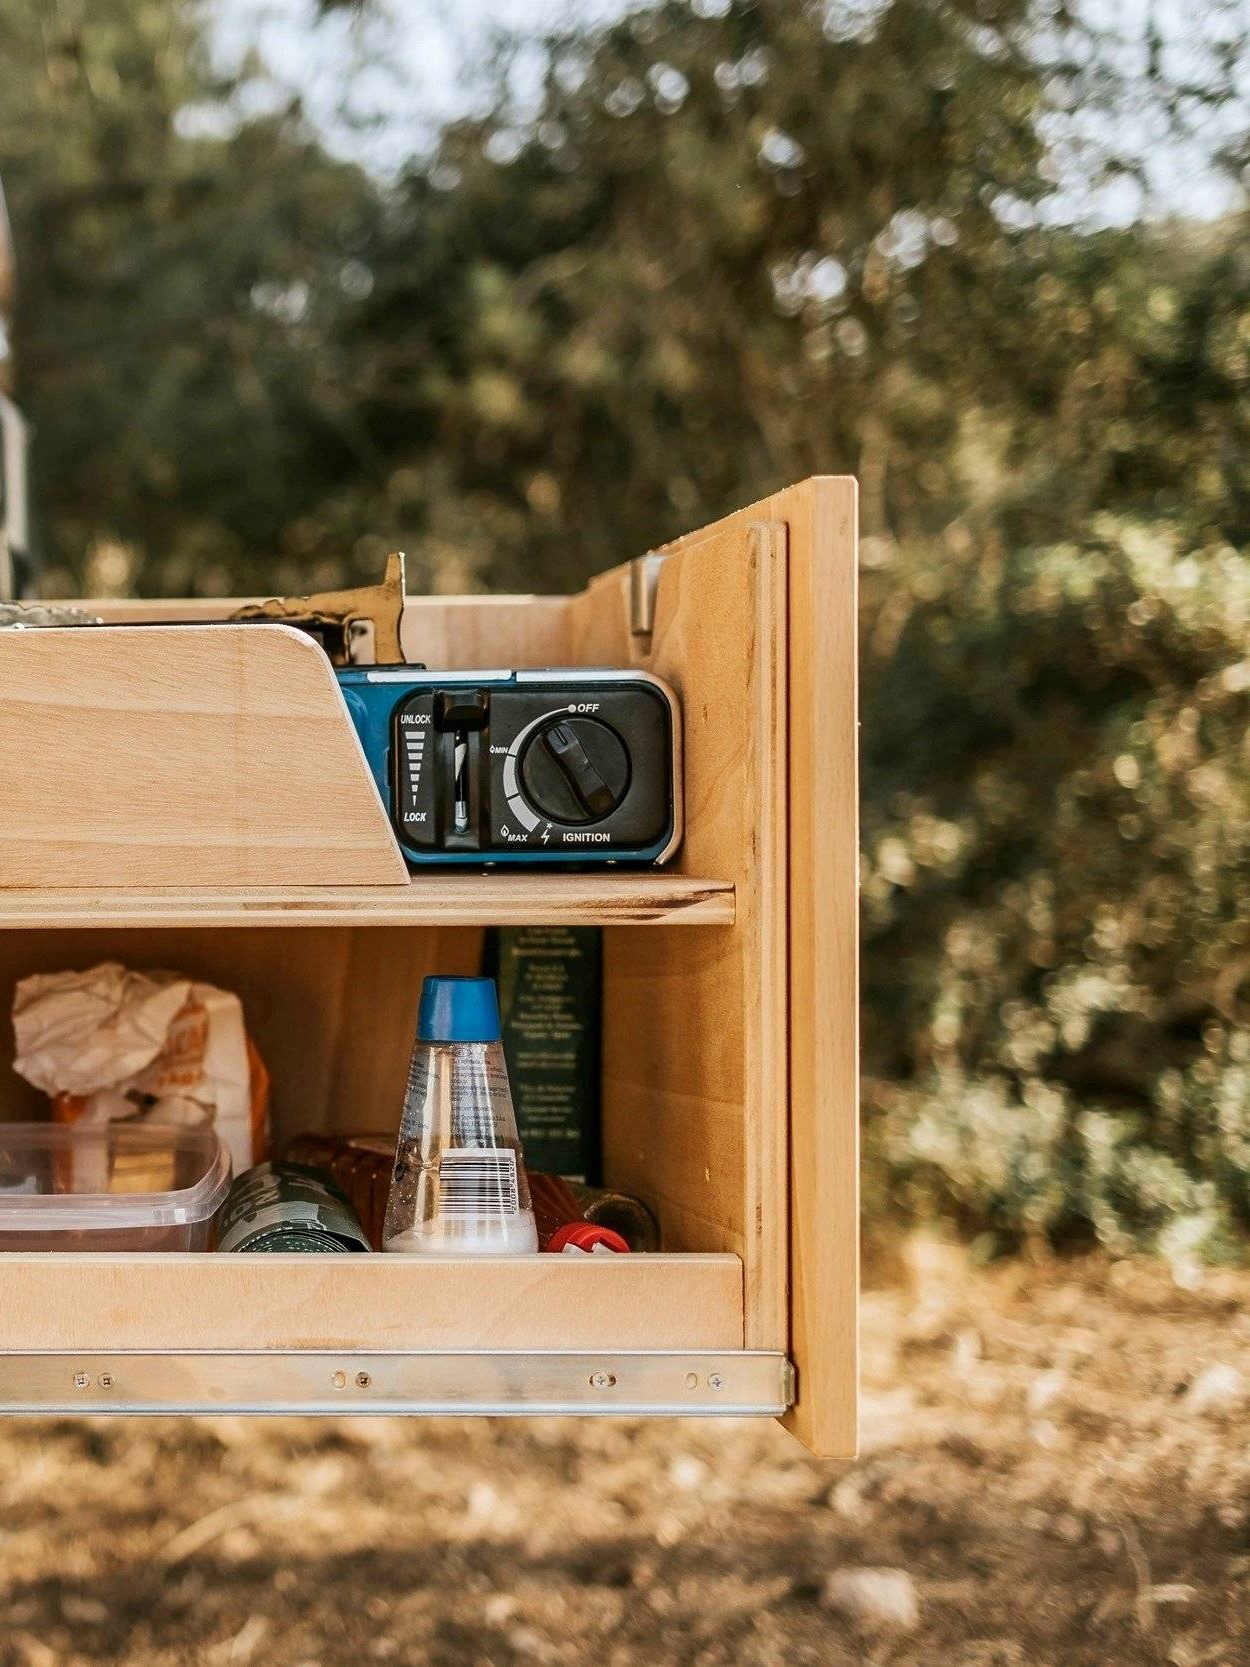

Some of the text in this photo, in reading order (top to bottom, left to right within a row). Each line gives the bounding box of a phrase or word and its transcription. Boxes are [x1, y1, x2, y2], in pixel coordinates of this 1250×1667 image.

[578, 703, 600, 713] OFF
[400, 714, 431, 725] UNLOCK
[495, 746, 509, 754] MIN
[403, 812, 426, 822] LOCK
[507, 833, 528, 842] MAX
[562, 832, 611, 842] IGNITION
